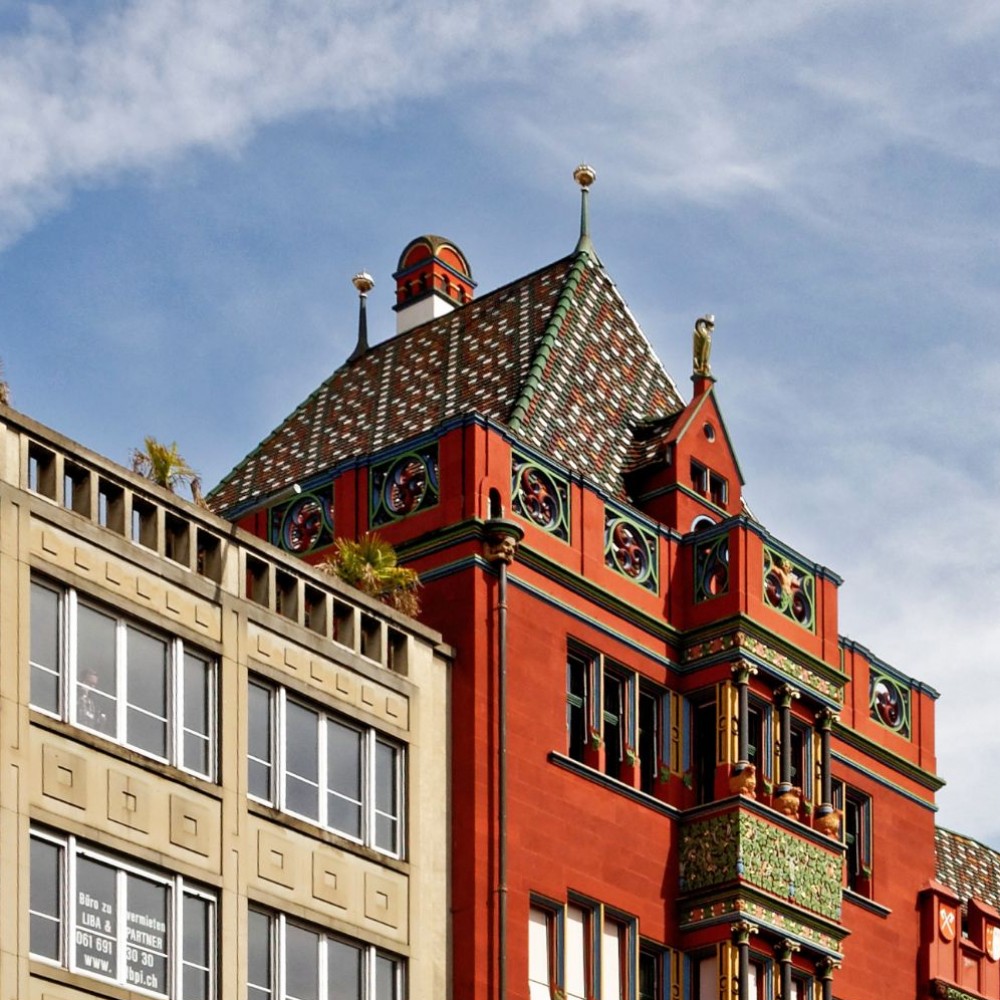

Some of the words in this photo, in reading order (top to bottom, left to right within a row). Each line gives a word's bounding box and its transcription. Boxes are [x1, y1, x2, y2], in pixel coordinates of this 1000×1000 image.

[79, 891, 99, 910] Büro
[101, 902, 112, 914] zu
[127, 911, 166, 932] vermieten
[82, 911, 102, 930] LIBA
[104, 919, 112, 933] &
[127, 926, 163, 949] PARTNER
[76, 930, 93, 949] 061
[96, 937, 112, 955] 691
[126, 947, 139, 963] 30
[141, 951, 154, 967] 30
[84, 954, 112, 973] www.
